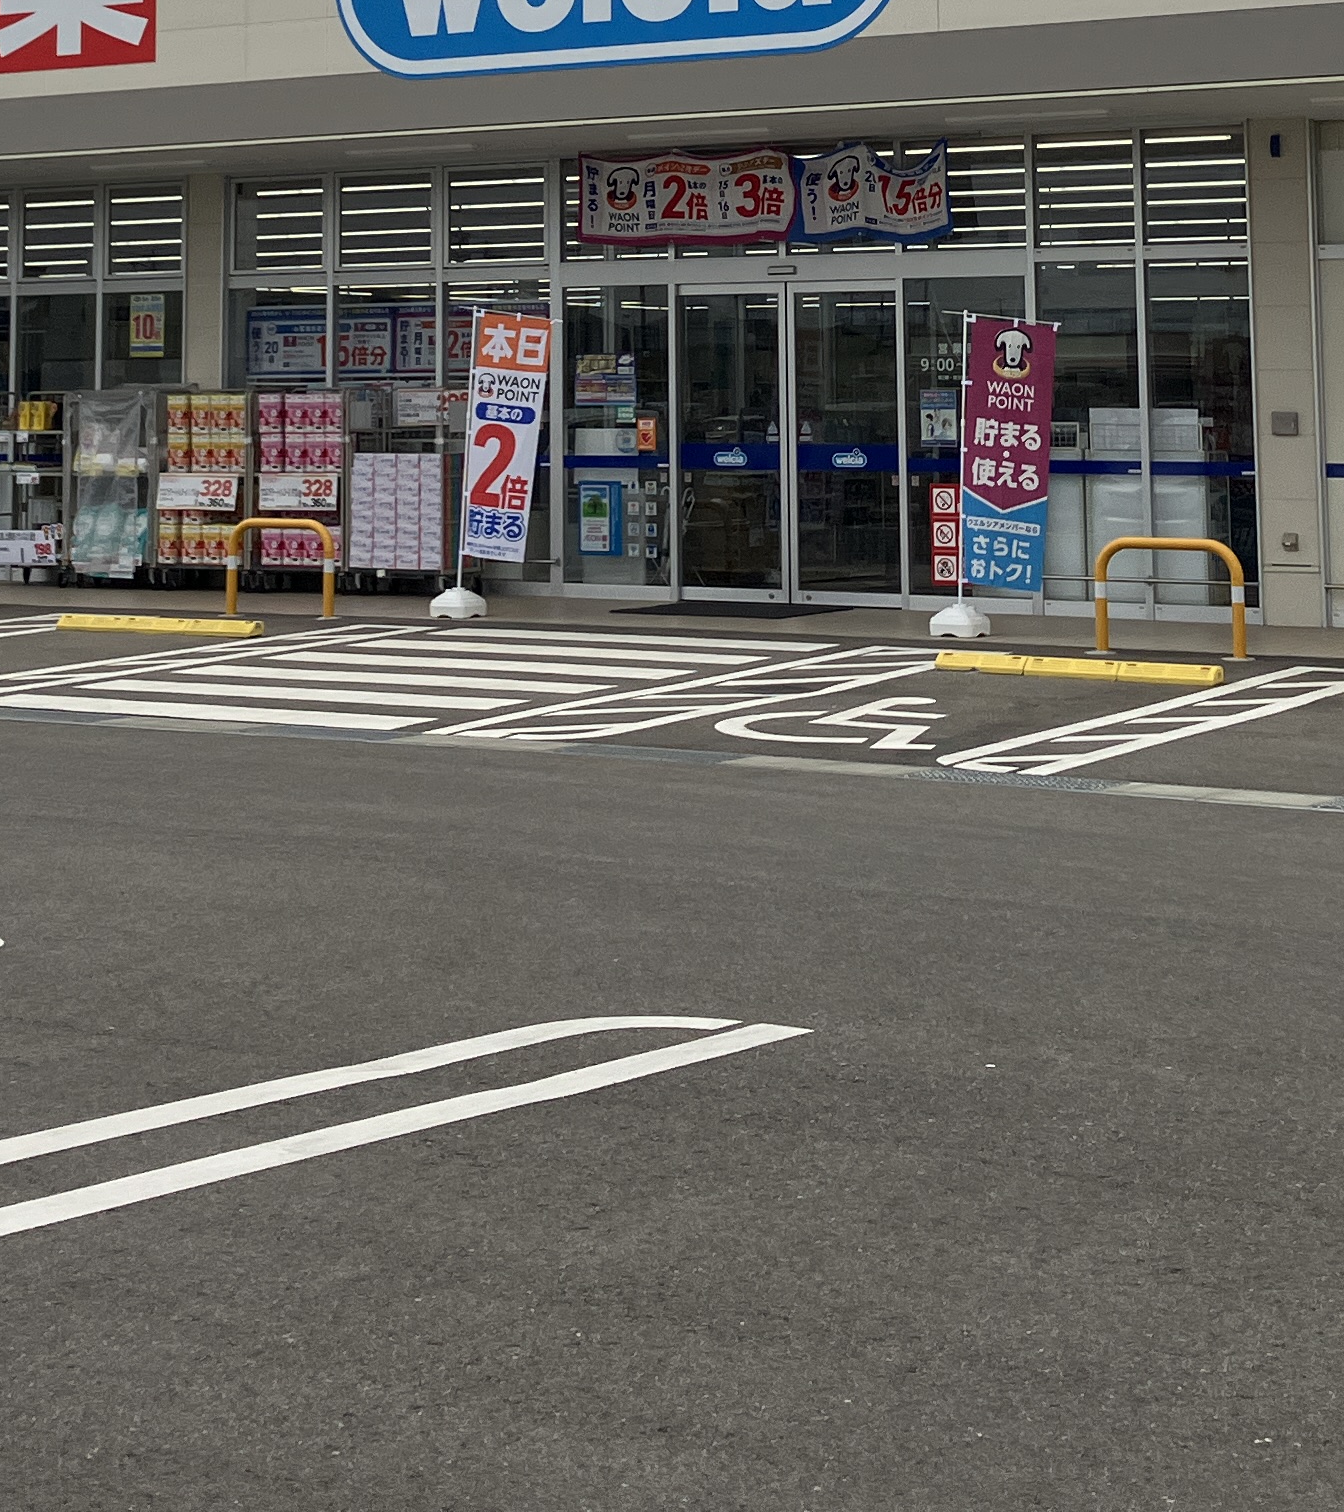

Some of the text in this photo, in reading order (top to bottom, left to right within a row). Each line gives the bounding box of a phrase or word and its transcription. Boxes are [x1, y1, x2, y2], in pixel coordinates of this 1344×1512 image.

[660, 174, 709, 220] 2倍
[734, 173, 785, 217] 3倍
[829, 200, 859, 214] WAON
[608, 212, 640, 222] WAON
[830, 211, 860, 225] POINT
[608, 222, 641, 233] POINT
[481, 323, 549, 366] 本日
[497, 374, 541, 390] WAON
[987, 381, 1035, 398] WAON
[496, 388, 539, 403] POINT
[987, 395, 1035, 412] POINT
[973, 417, 1042, 451] 貯まる
[470, 423, 529, 511] 2倍
[971, 456, 1040, 491] 使える
[199, 479, 233, 498] 328
[302, 479, 333, 498] 328
[468, 507, 525, 541] 貯まる
[972, 534, 1030, 559] さらに
[970, 558, 1032, 584] おトク!
